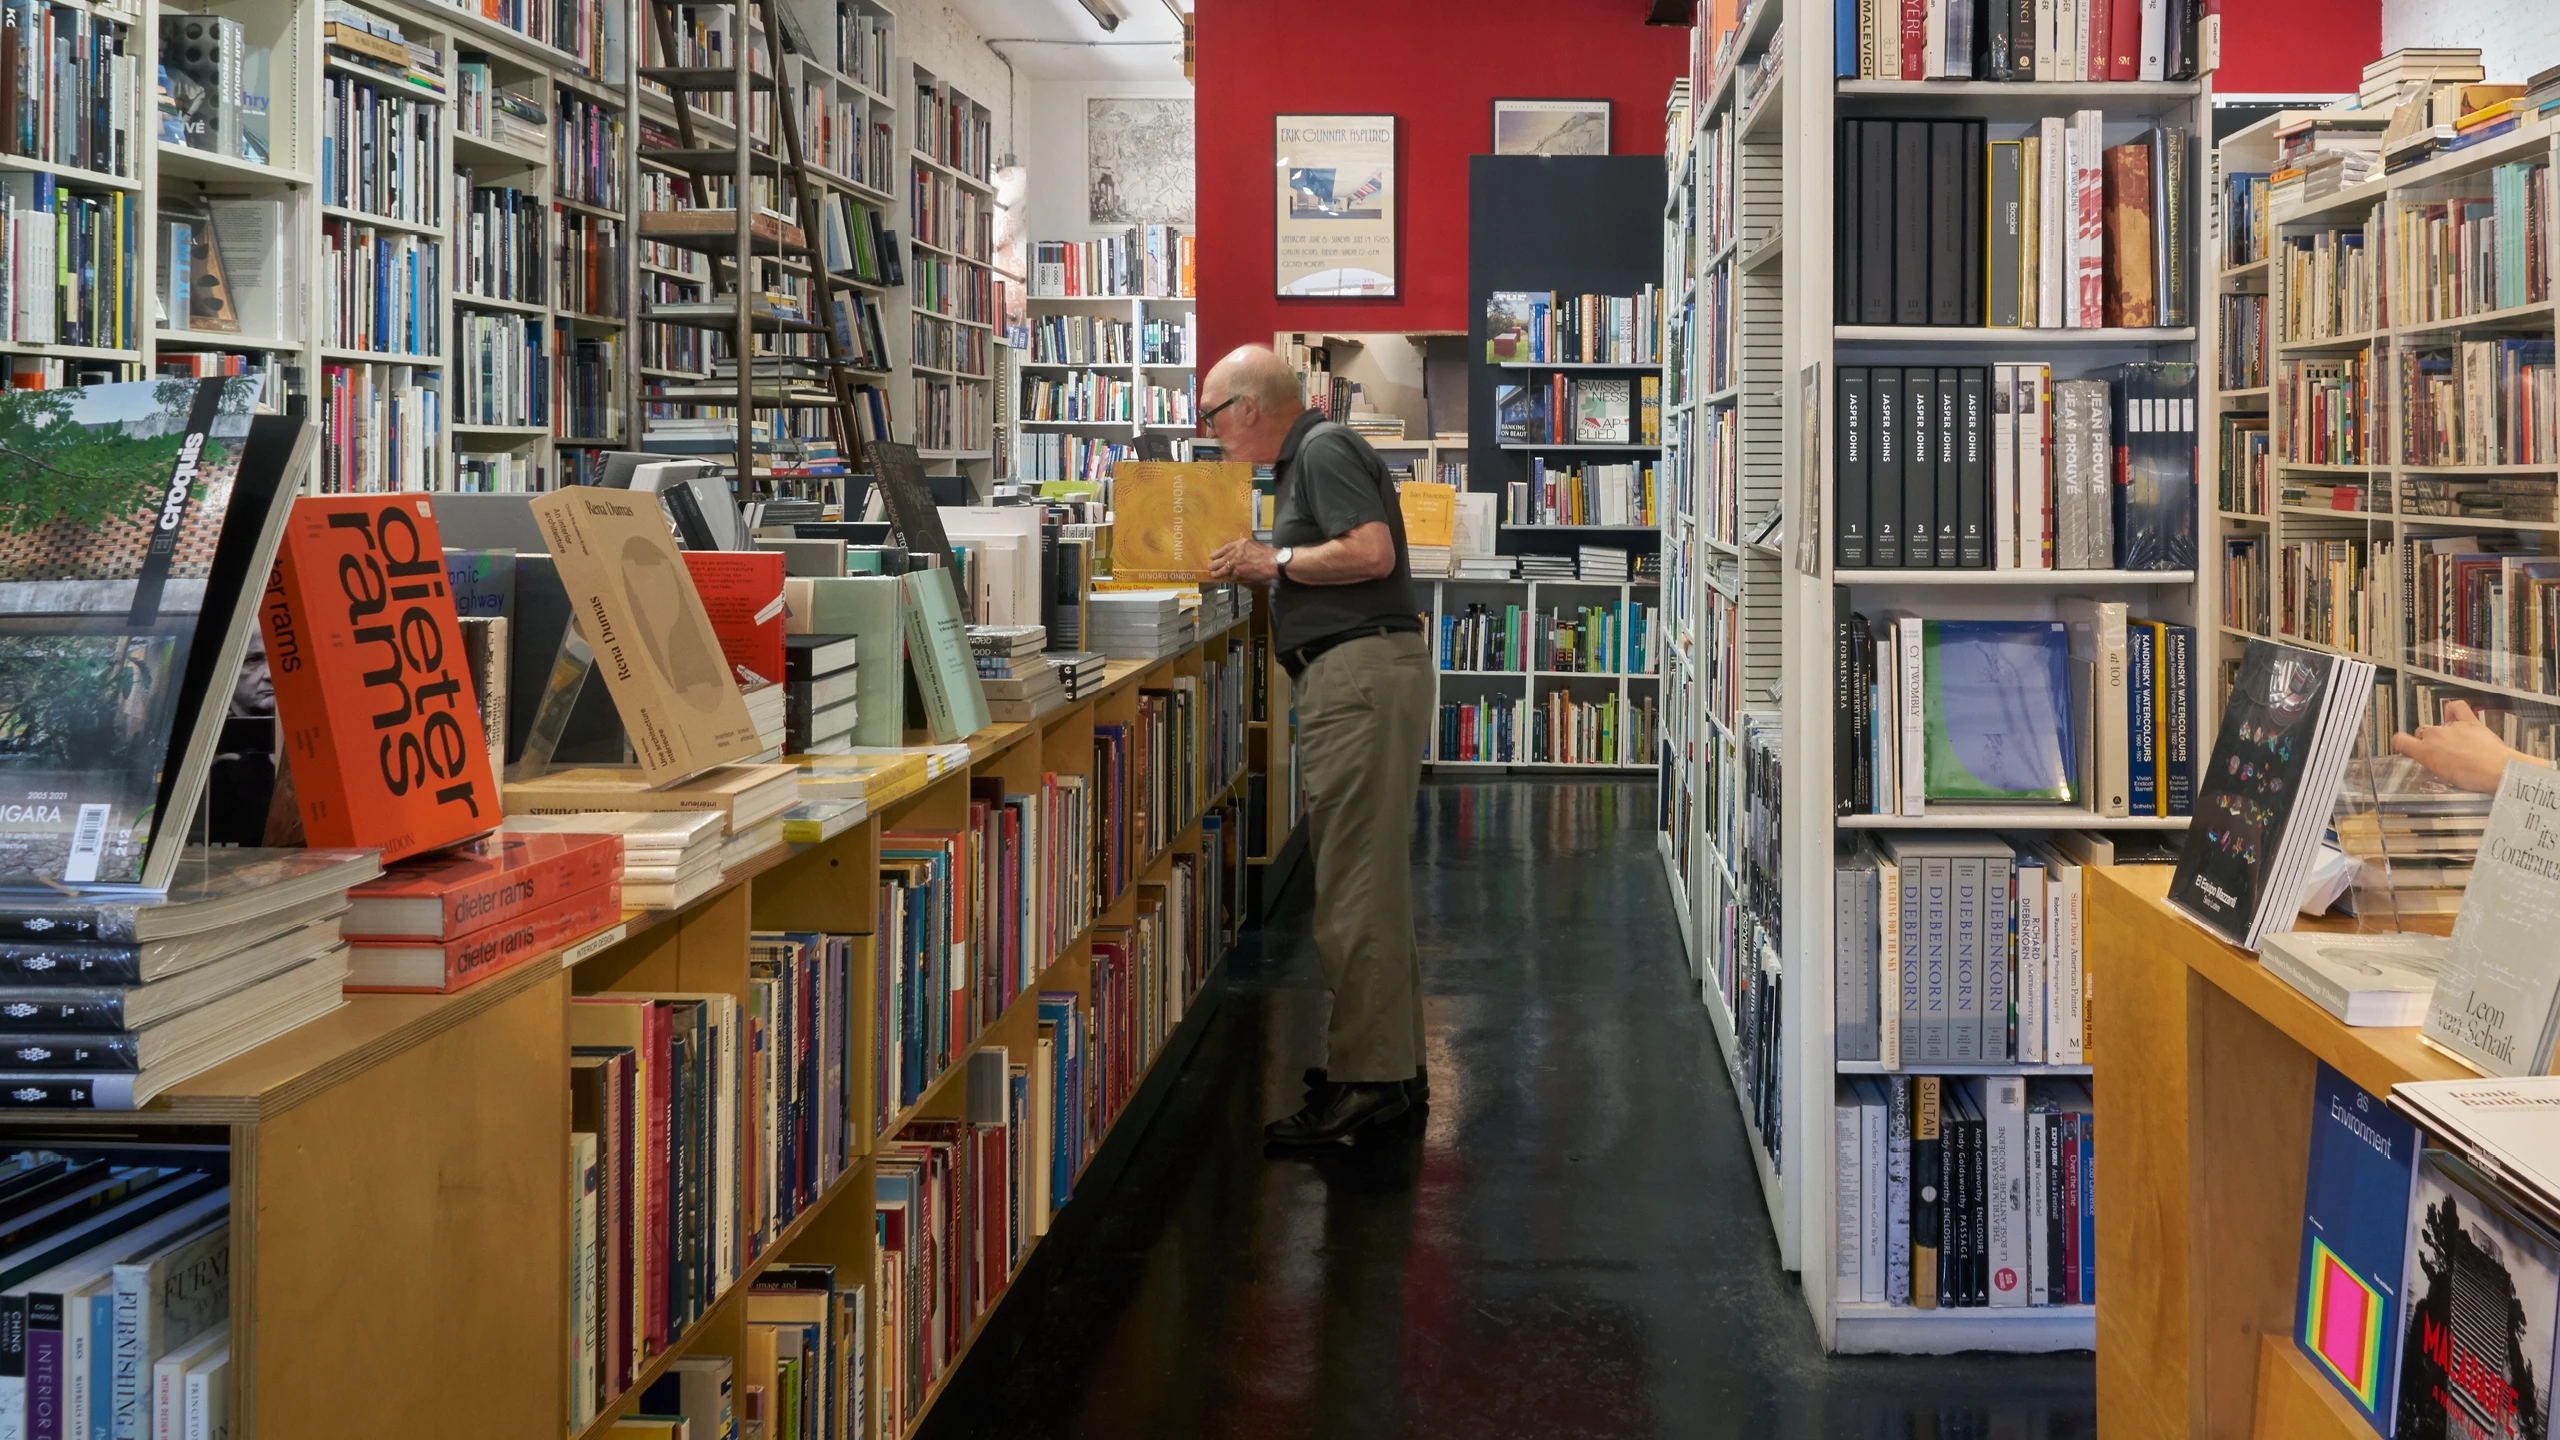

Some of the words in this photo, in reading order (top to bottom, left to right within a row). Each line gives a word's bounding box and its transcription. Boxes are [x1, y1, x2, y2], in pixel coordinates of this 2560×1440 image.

[1863, 0, 1871, 76] MALEVICH
[2080, 28, 2088, 72] Painting
[1281, 129, 1300, 142] ERIK
[1303, 129, 1347, 142] GUNNAR
[1350, 129, 1390, 142] ASPLUND
[2070, 170, 2079, 213] TWOMBLY
[2010, 202, 2018, 235] Boccioni
[1592, 391, 1628, 402] NESS
[2065, 391, 2075, 430] JEAN
[2091, 390, 2103, 429] JEAN
[160, 432, 204, 530] croquis
[867, 444, 884, 483] CRAFTING
[2091, 433, 2107, 494] PROUVÉ
[585, 500, 606, 516] Rena
[607, 501, 634, 517] Dumas
[1174, 474, 1183, 513] ONODA
[544, 511, 567, 554] architecture
[556, 518, 573, 545] interior
[1174, 516, 1183, 561] MINORU
[1851, 525, 1856, 533] 1
[1884, 525, 1890, 533] 2
[1917, 525, 1924, 533] 3
[1944, 525, 1950, 533] 4
[1970, 525, 1976, 533] 5
[269, 602, 301, 675] rams
[590, 595, 615, 643] Dumas
[1840, 623, 1847, 637] LA
[327, 512, 425, 797] rams
[376, 506, 479, 819] dieter
[611, 644, 631, 682] Rena
[1910, 645, 1919, 660] CY
[2111, 653, 2121, 665] at
[2142, 635, 2150, 687] KANDINSKY
[2177, 635, 2185, 687] KANDINSKY
[1910, 664, 1920, 717] TWOMBLY
[2111, 668, 2121, 686] 100
[640, 708, 661, 751] architecture
[2142, 689, 2152, 762] WATERCOLOURS
[2178, 689, 2186, 762] WATERCOLOURS
[655, 748, 667, 767] Une
[27, 791, 48, 800] 2005
[49, 791, 68, 800] 2021
[2525, 807, 2540, 830] in
[2537, 824, 2557, 851] its
[115, 828, 131, 856] 212
[455, 891, 497, 923] dieter
[500, 878, 535, 909] rams
[1888, 875, 1897, 917] REACHING
[2201, 879, 2216, 896] Equipo
[2217, 887, 2238, 908] Mazzanti
[577, 941, 598, 958] INTERIOR
[599, 935, 615, 948] DESIGN
[1888, 919, 1897, 935] FOR
[1888, 938, 1897, 954] THE
[1959, 885, 1973, 1011] DIEBENKORN
[2021, 898, 2030, 960] DIEBENKORN
[2032, 917, 2040, 960] RICHARD
[2070, 923, 2078, 945] Davis
[458, 939, 498, 974] dieter
[501, 926, 535, 956] rams
[1904, 886, 1917, 1011] DIEBENKORN
[1928, 886, 1943, 1011] DIEBENKORN
[1990, 887, 2004, 1012] DIEBENKORN
[2465, 991, 2505, 1030] Leon
[2437, 1009, 2462, 1037] van
[2464, 1019, 2515, 1065] Schaik
[1923, 1082, 1935, 1136] SULTAN
[2357, 1091, 2369, 1113] as
[2448, 1088, 2518, 1099] Iconic
[2331, 1094, 2392, 1159] Environment
[1942, 1152, 1950, 1204] Goldsworthy
[1958, 1153, 1966, 1209] Goldsworthy
[1974, 1151, 1983, 1203] Goldsworthy
[1992, 1145, 2000, 1192] ROSARUM
[1871, 1209, 1879, 1230] Cool
[1943, 1207, 1952, 1255] ENCLOSURE
[1959, 1214, 1968, 1259] PASSAGE
[1976, 1207, 1984, 1255] ENCLOSURE
[2000, 1225, 2008, 1249] ROSE
[1871, 1238, 1879, 1256] Warm
[756, 1281, 779, 1289] image
[782, 1280, 797, 1288] and
[12, 1311, 21, 1353] CHING
[116, 1292, 137, 1426] FURNISHING
[2423, 1310, 2519, 1438] MALAPARTE
[37, 1344, 52, 1429] INTERIOR
[75, 1376, 83, 1418] MATERIALS
[2432, 1385, 2439, 1399] A
[2439, 1391, 2465, 1427] HOUSE
[2466, 1417, 2488, 1440] LIKE
